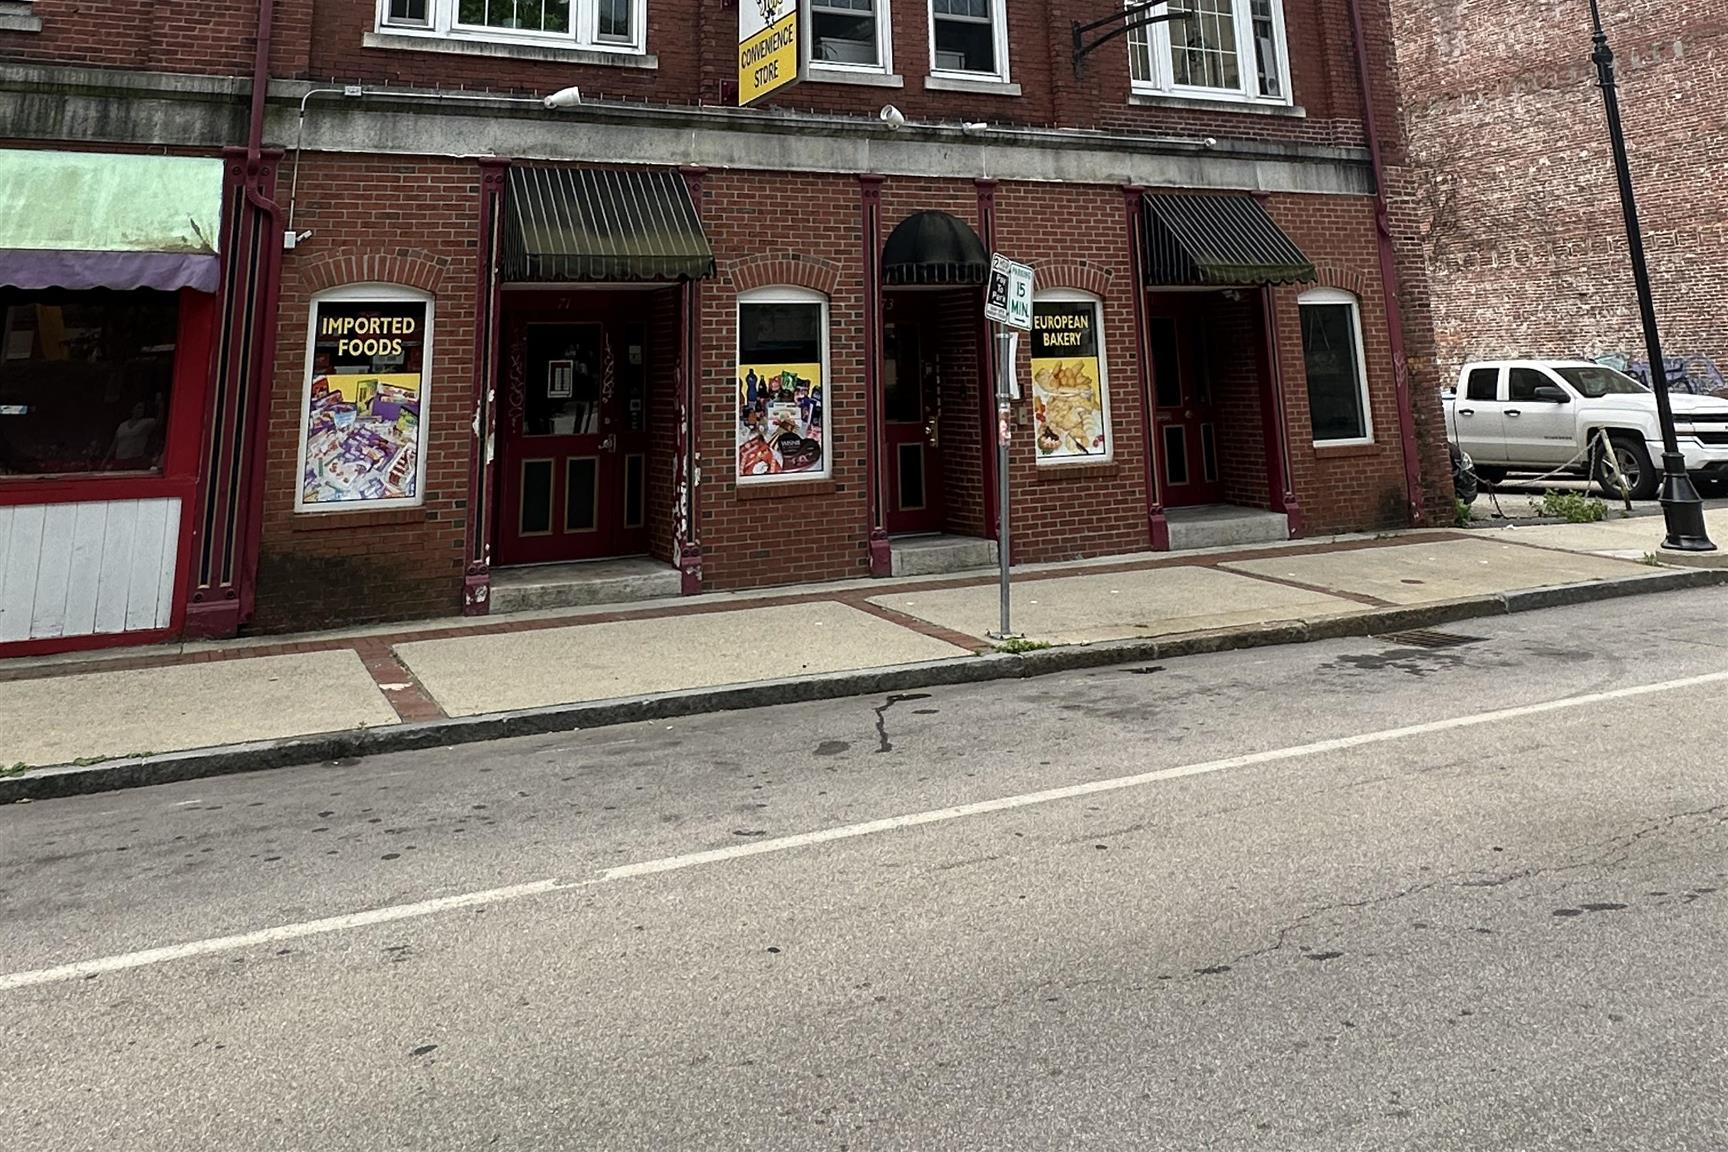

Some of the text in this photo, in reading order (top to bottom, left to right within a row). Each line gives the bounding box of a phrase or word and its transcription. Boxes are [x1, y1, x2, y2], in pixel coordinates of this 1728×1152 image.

[741, 23, 794, 69] CONVENIENCE
[754, 59, 779, 89] STORE
[1016, 281, 1026, 298] 15
[321, 317, 416, 336] IMPORTED
[1034, 315, 1089, 330] EUROPEAN
[338, 338, 403, 357] FOODS
[1043, 332, 1082, 347] BAKERY
